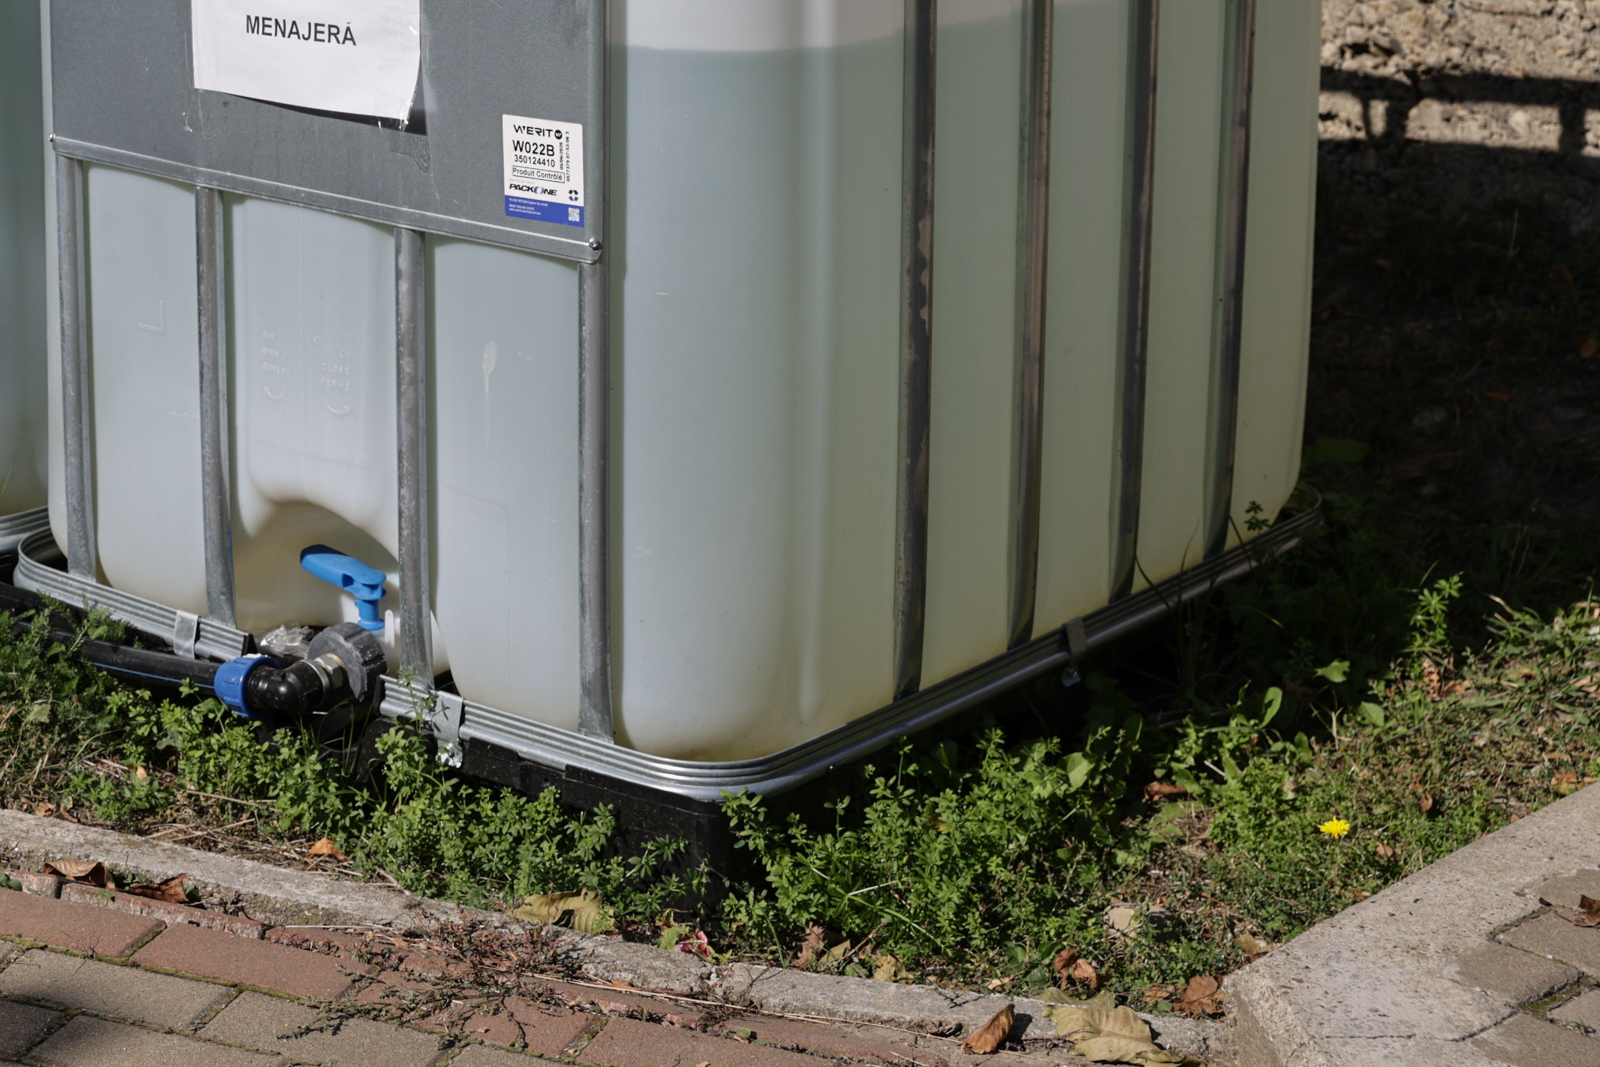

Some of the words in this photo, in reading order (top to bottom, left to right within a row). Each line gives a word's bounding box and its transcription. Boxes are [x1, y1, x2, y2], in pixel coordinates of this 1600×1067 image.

[513, 124, 554, 138] WERIT
[512, 139, 555, 157] W022B
[513, 154, 556, 168] 350124410
[513, 168, 535, 177] Produit
[536, 170, 563, 181] Contrôlé
[261, 346, 279, 358] OPEN
[262, 361, 290, 377] OUVERT
[322, 362, 350, 376] CLOSE
